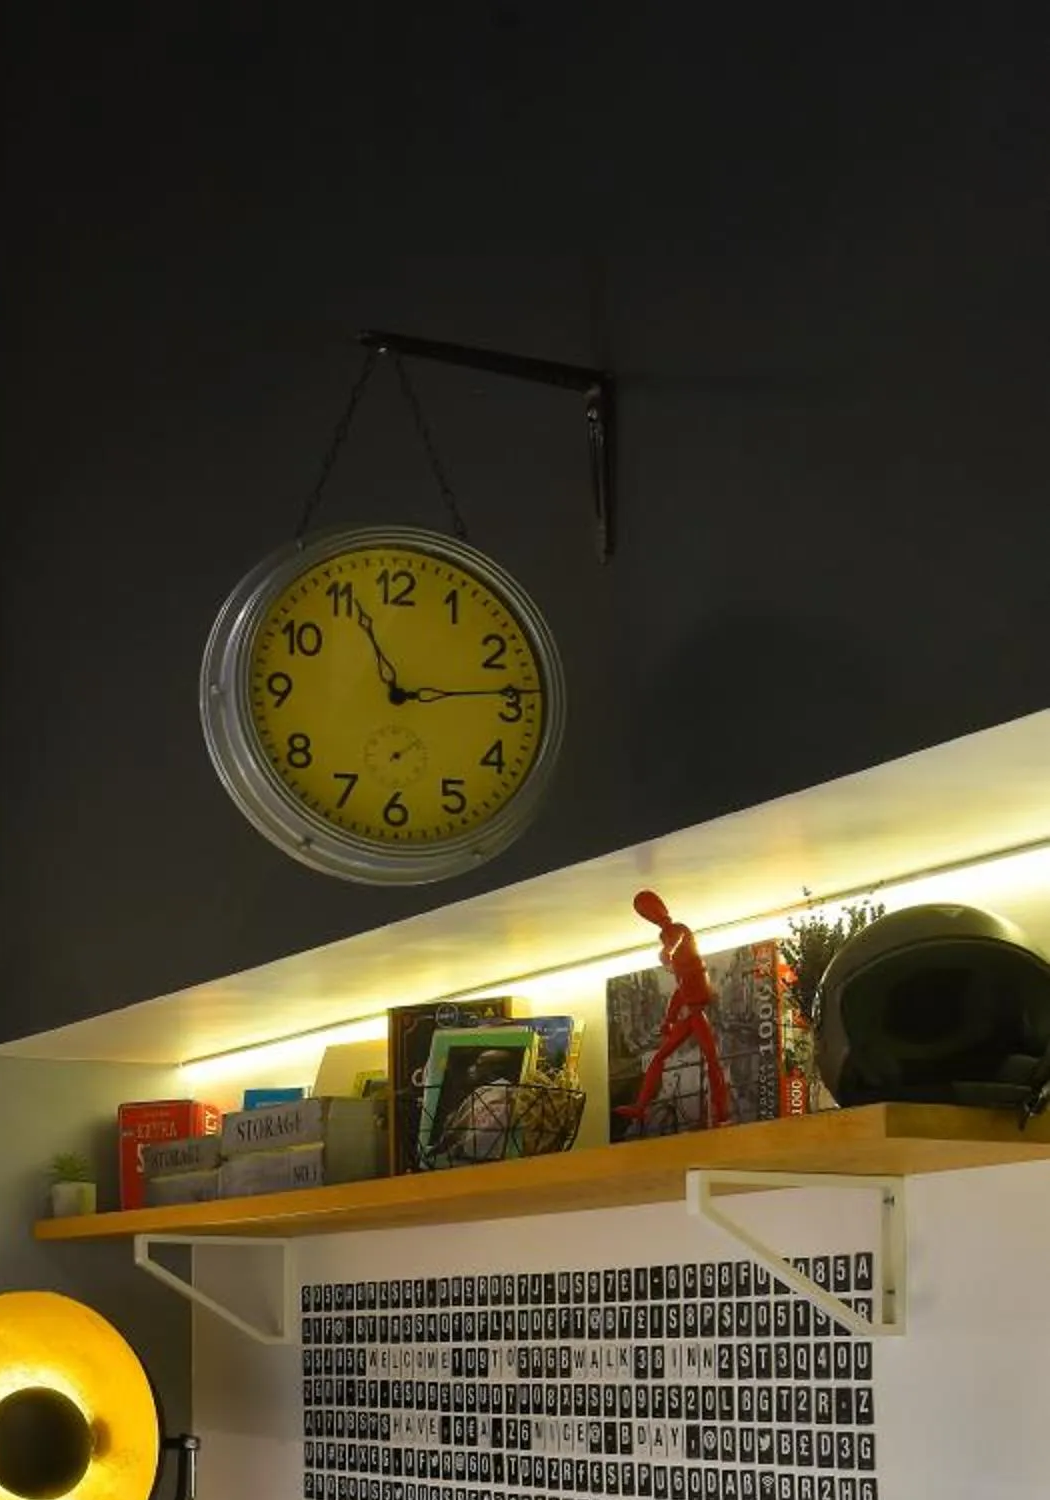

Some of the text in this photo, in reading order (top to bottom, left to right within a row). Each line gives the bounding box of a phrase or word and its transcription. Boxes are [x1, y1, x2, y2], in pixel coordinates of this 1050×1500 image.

[326, 582, 354, 617] 11
[376, 570, 417, 607] 12
[445, 589, 458, 625] 1
[281, 620, 322, 656] 10
[481, 634, 507, 670] 2
[267, 672, 292, 708] 9
[498, 685, 523, 722] 3
[287, 733, 312, 769] 8
[480, 740, 506, 774] 4
[333, 774, 358, 809] 7
[441, 779, 466, 814] 5
[383, 792, 408, 827] 6
[237, 1111, 302, 1142] STORAGE
[368, 1351, 450, 1369] WELCOME
[490, 1348, 515, 1366] TO
[573, 1349, 628, 1368] WALK
[672, 1347, 713, 1367] INN
[392, 1416, 435, 1435] HAVE
[637, 1426, 679, 1446] DAY
